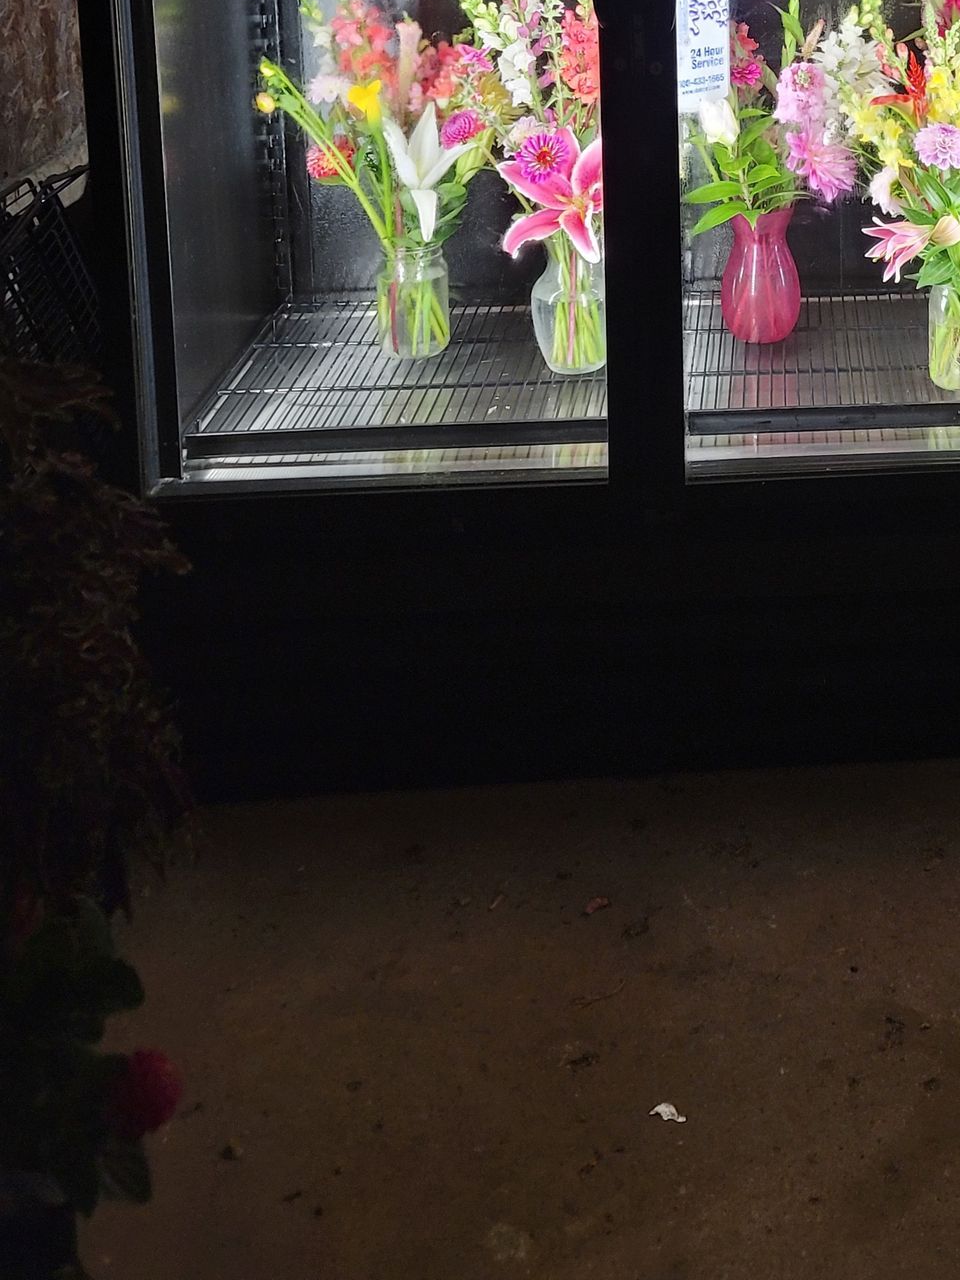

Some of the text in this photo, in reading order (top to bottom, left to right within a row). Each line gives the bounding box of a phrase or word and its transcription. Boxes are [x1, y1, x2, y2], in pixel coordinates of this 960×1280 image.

[690, 46, 724, 59] 24 Hour
[691, 56, 724, 70] Service
